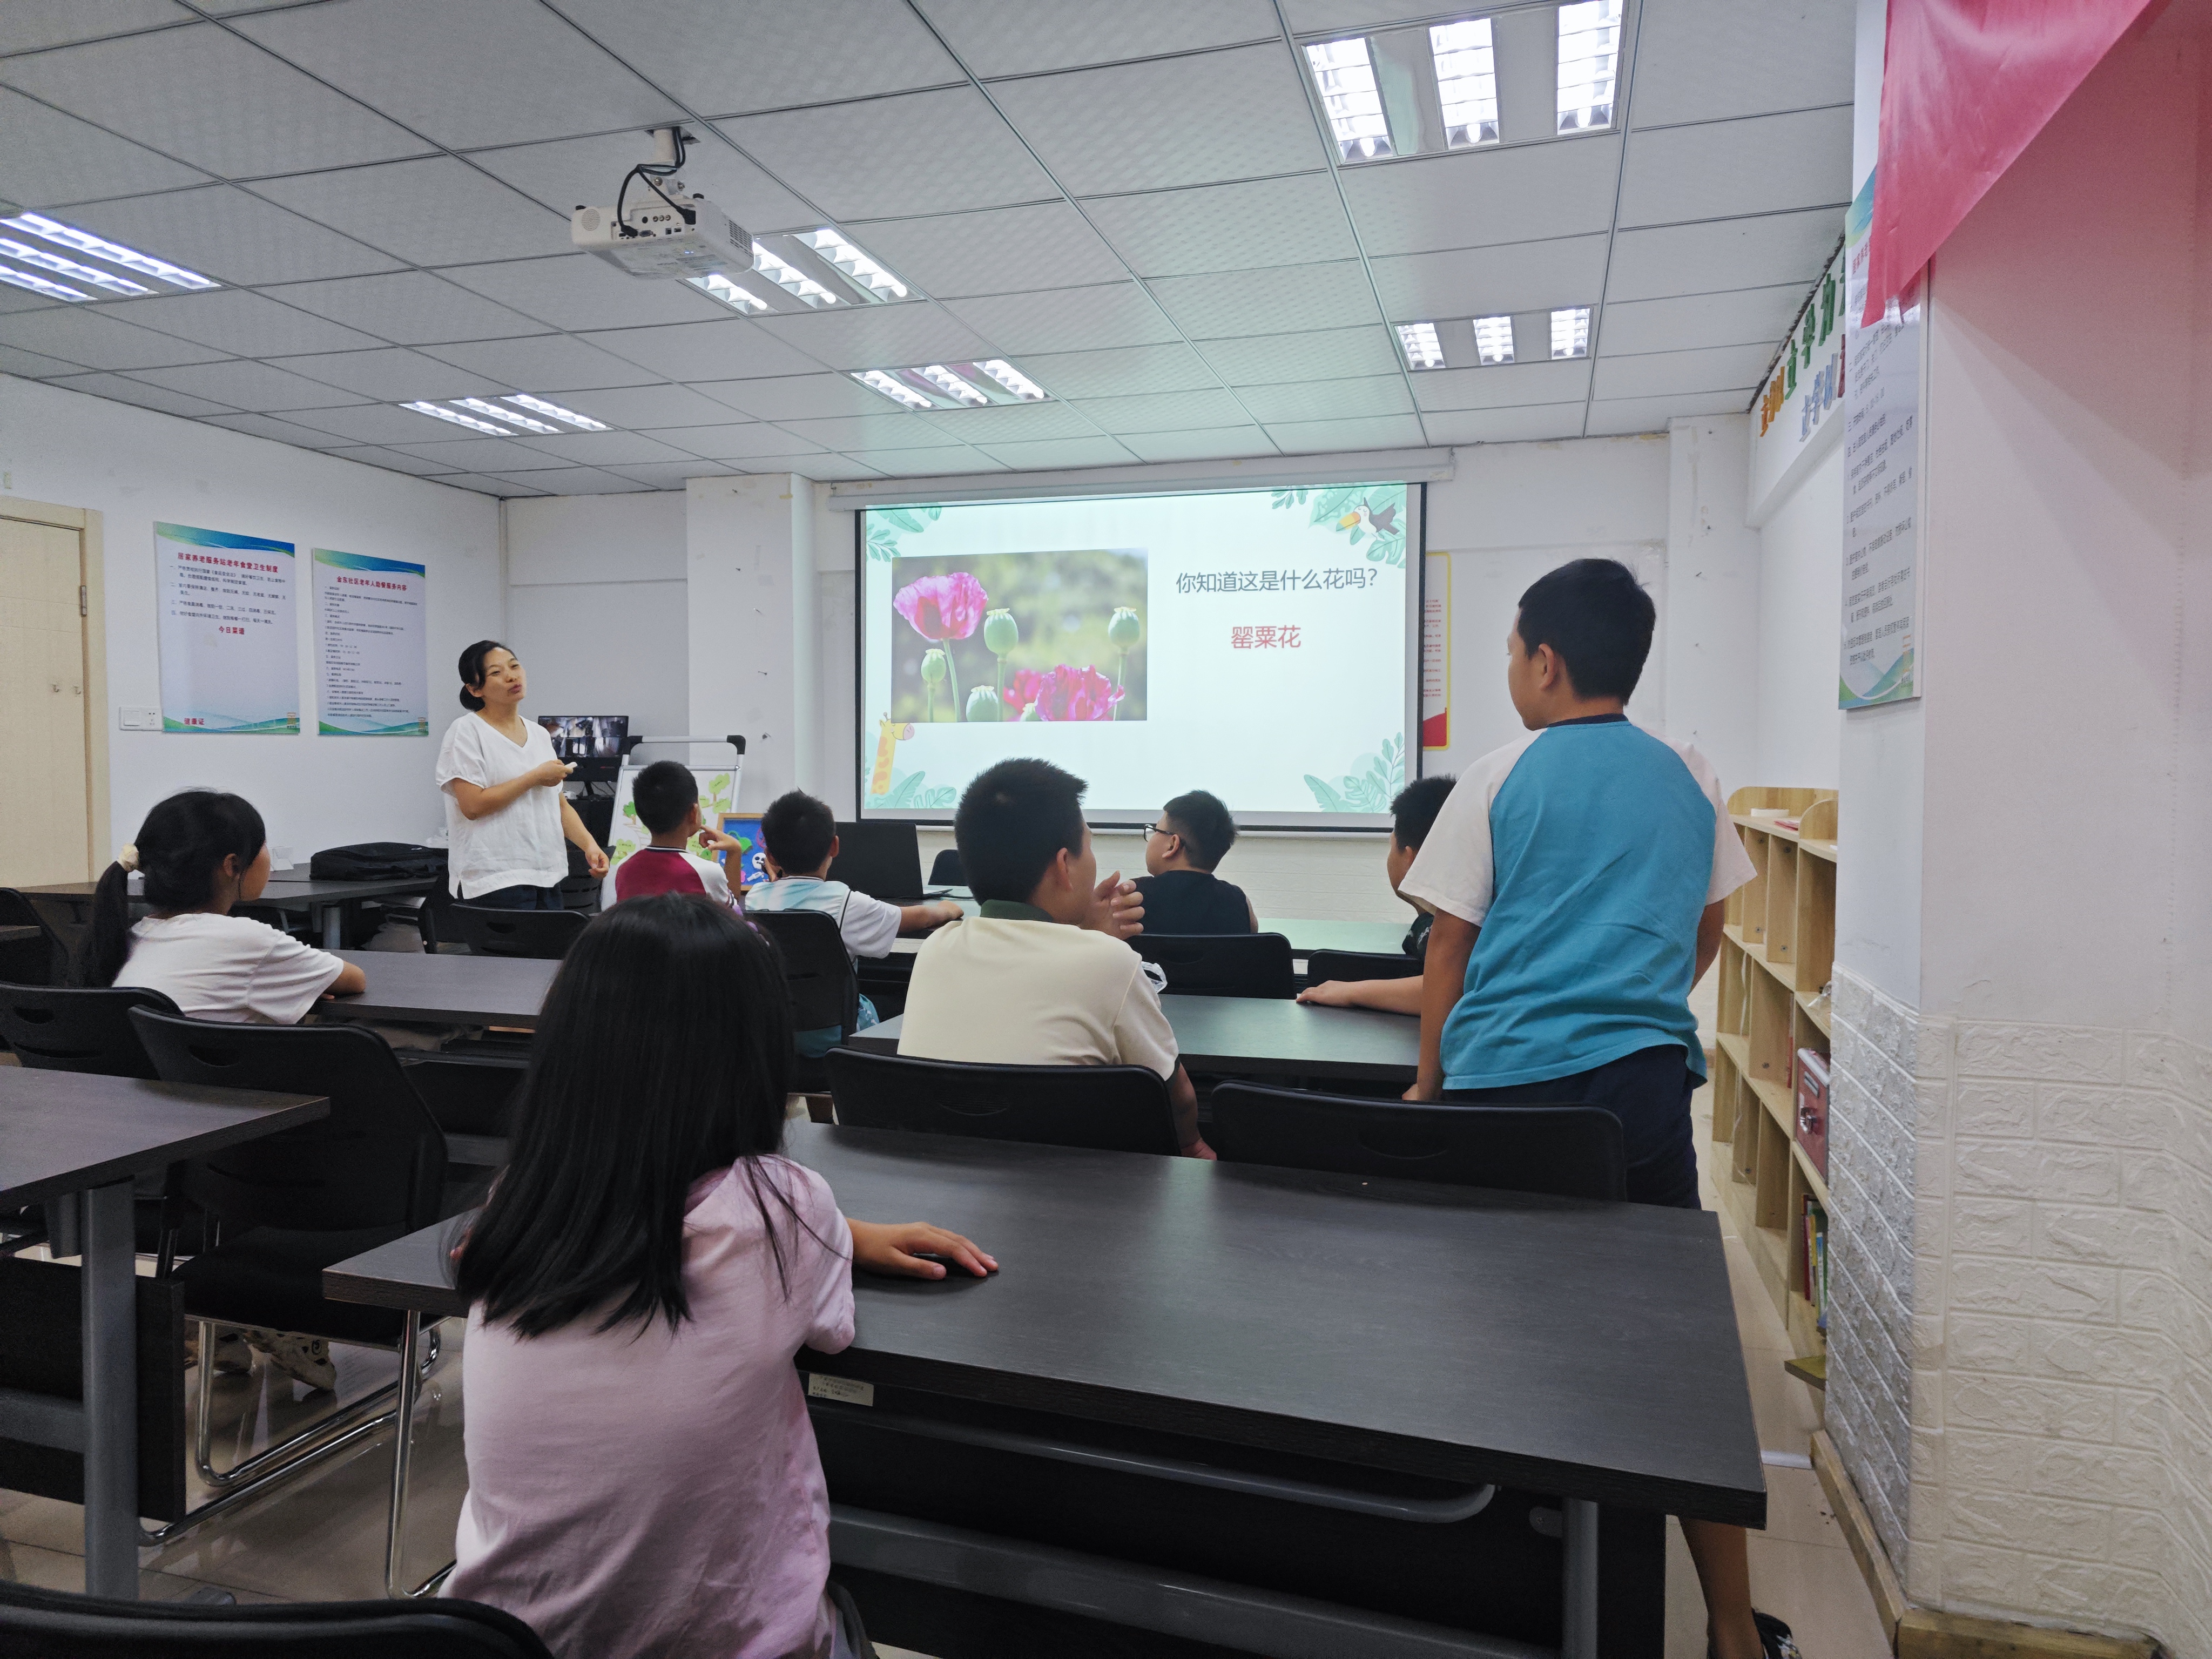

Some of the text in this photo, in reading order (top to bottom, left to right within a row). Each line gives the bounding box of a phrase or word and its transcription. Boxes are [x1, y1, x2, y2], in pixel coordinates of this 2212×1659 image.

[1176, 568, 1378, 594] 你知道这是什么花吗?
[1231, 624, 1301, 649] 罂粟花
